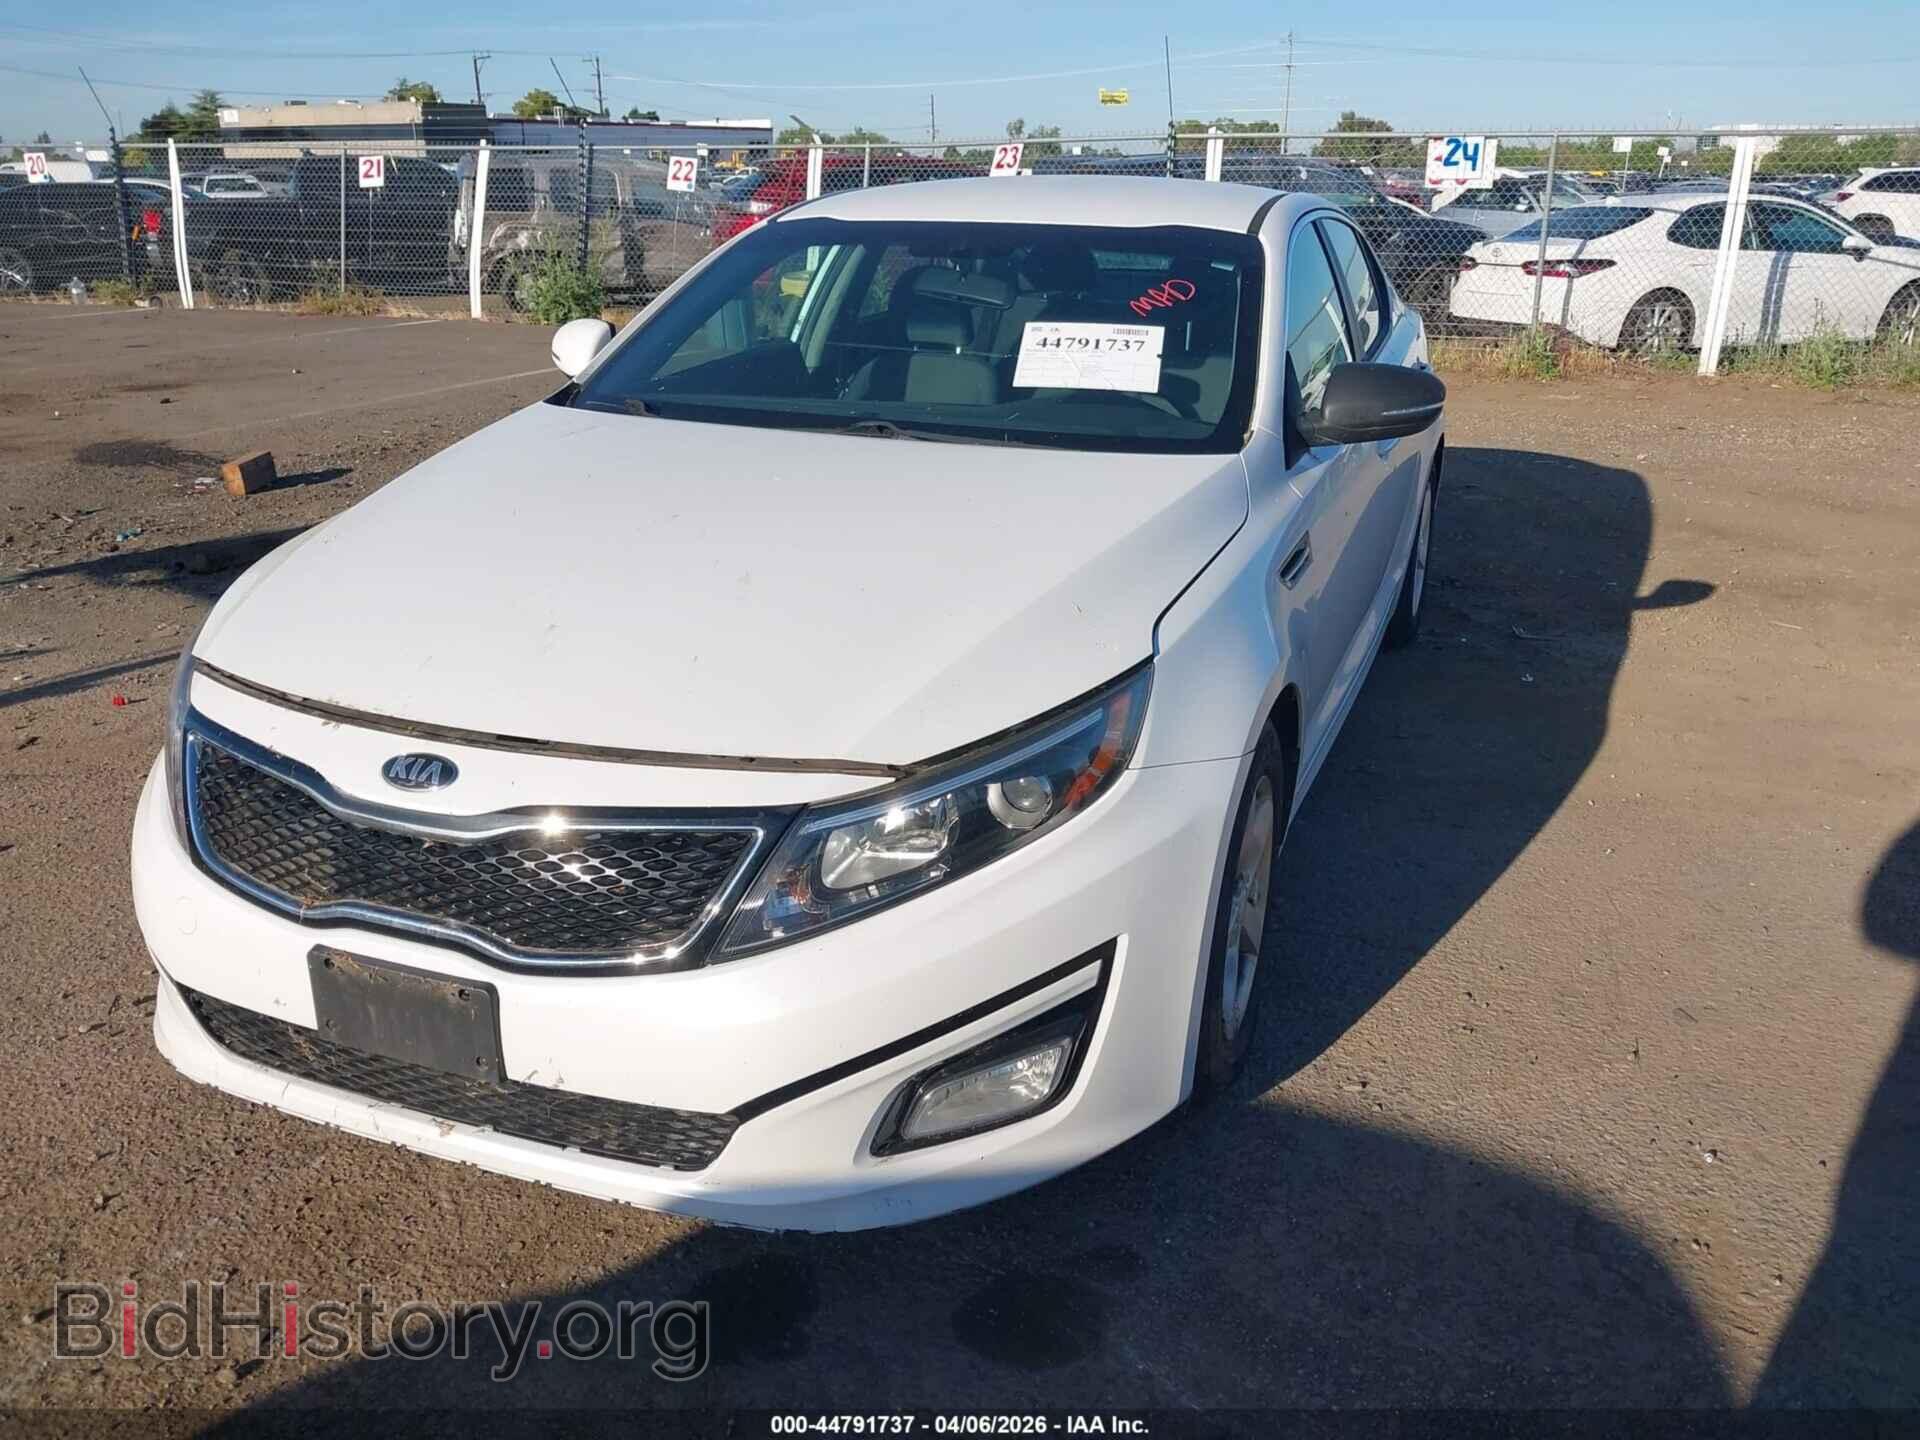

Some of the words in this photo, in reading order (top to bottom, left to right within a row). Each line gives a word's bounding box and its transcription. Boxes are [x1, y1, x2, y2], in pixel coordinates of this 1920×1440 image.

[27, 155, 46, 175] 20
[994, 146, 1020, 169] 23
[1443, 138, 1480, 172] 24
[362, 159, 382, 178] 21
[671, 160, 695, 182] 22
[1035, 336, 1146, 352] 44791737
[388, 757, 443, 785] KIA
